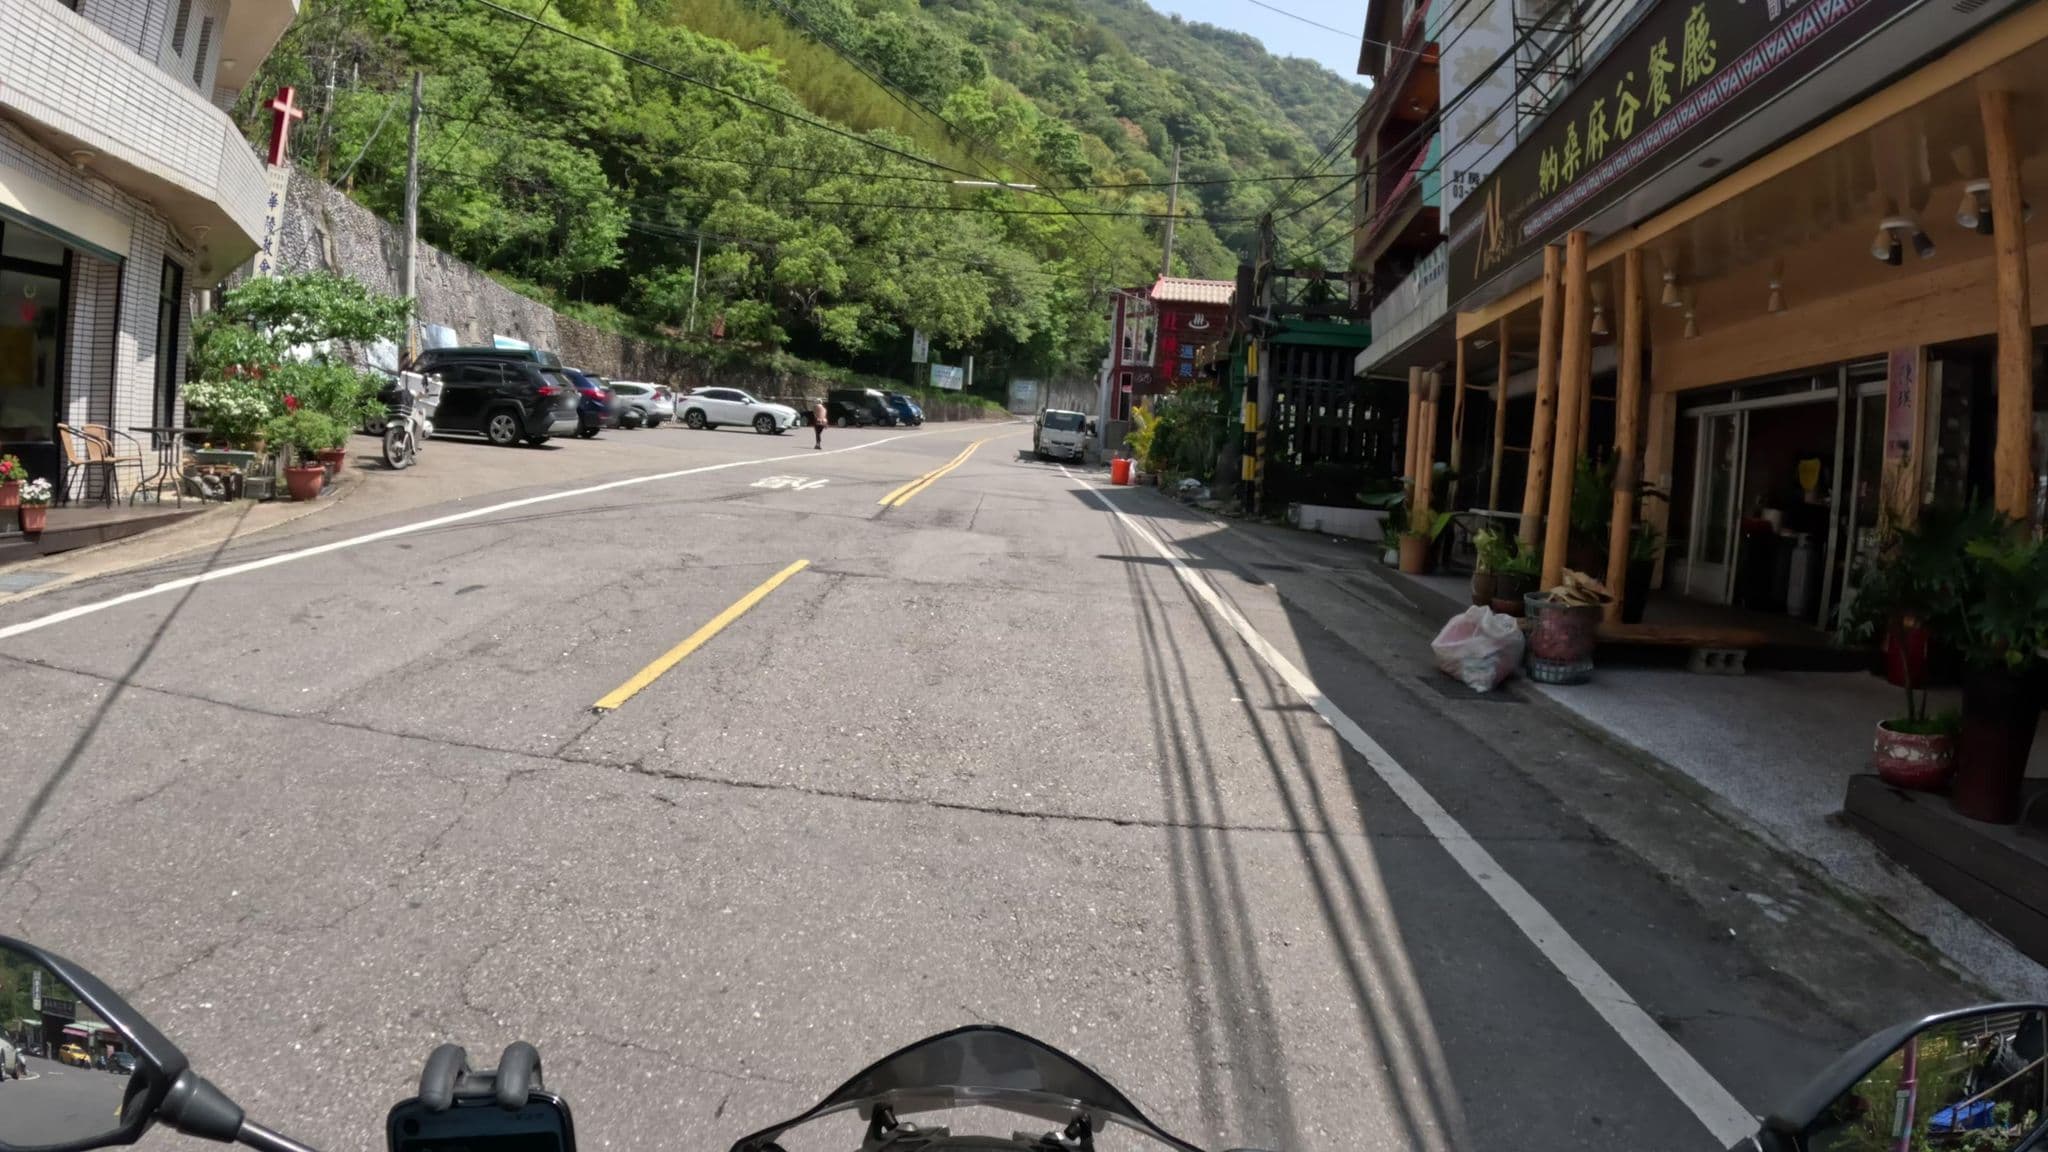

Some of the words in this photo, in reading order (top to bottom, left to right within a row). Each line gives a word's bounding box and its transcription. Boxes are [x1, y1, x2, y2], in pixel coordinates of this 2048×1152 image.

[1539, 3, 1717, 198] 納桑麻谷餐廳
[1453, 170, 1491, 184] 訂房
